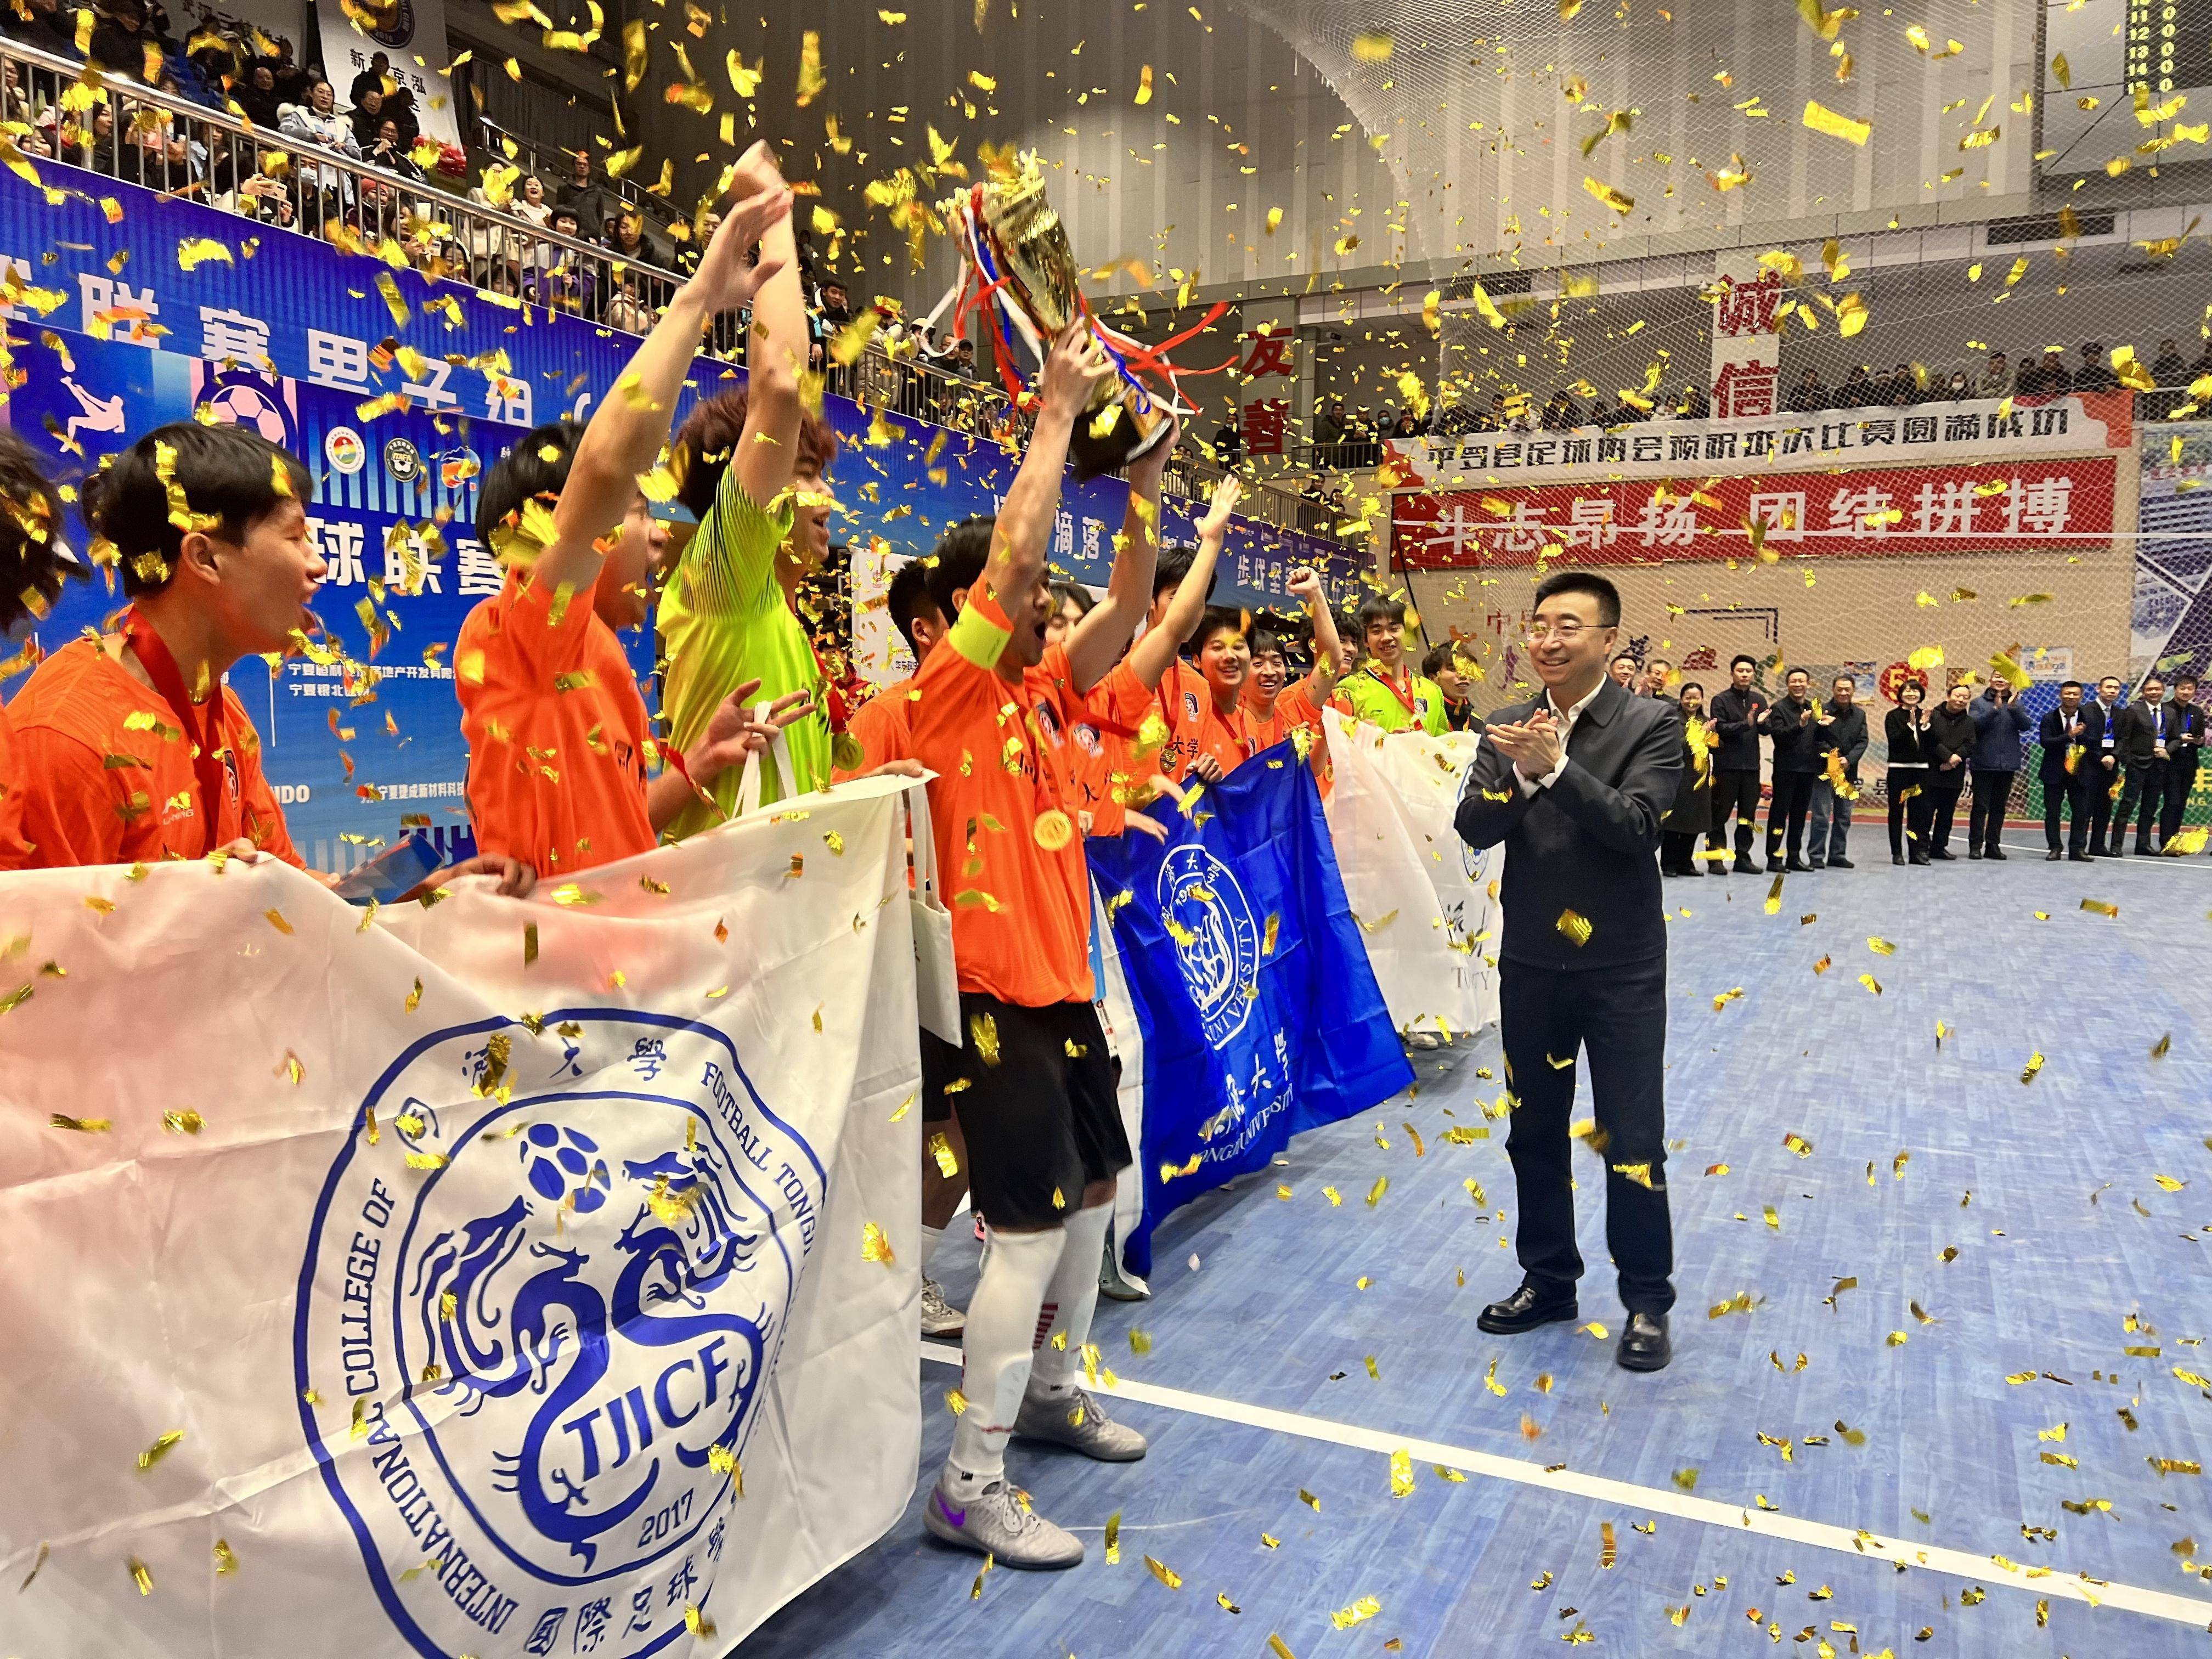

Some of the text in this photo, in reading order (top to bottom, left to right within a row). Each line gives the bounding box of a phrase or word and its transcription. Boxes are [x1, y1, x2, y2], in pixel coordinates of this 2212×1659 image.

[2130, 23, 2175, 41] 12 0
[2131, 6, 2176, 24] 11 0
[2129, 42, 2174, 59] 13 0
[2129, 59, 2174, 77] 14 0
[2159, 77, 2172, 93] 0
[1706, 269, 1781, 418] 诚信
[1242, 321, 1294, 454] 友善
[1426, 496, 1696, 554] 斗志昂扬
[1750, 477, 2070, 543] 团结拼搏
[701, 1062, 772, 1171] FOOTBALL
[362, 1177, 394, 1228] OF
[342, 1232, 381, 1396] COLLEGE
[562, 1335, 729, 1482] TJICF
[366, 1401, 519, 1634] INTERNATIONAL
[637, 1488, 693, 1548] 2017
